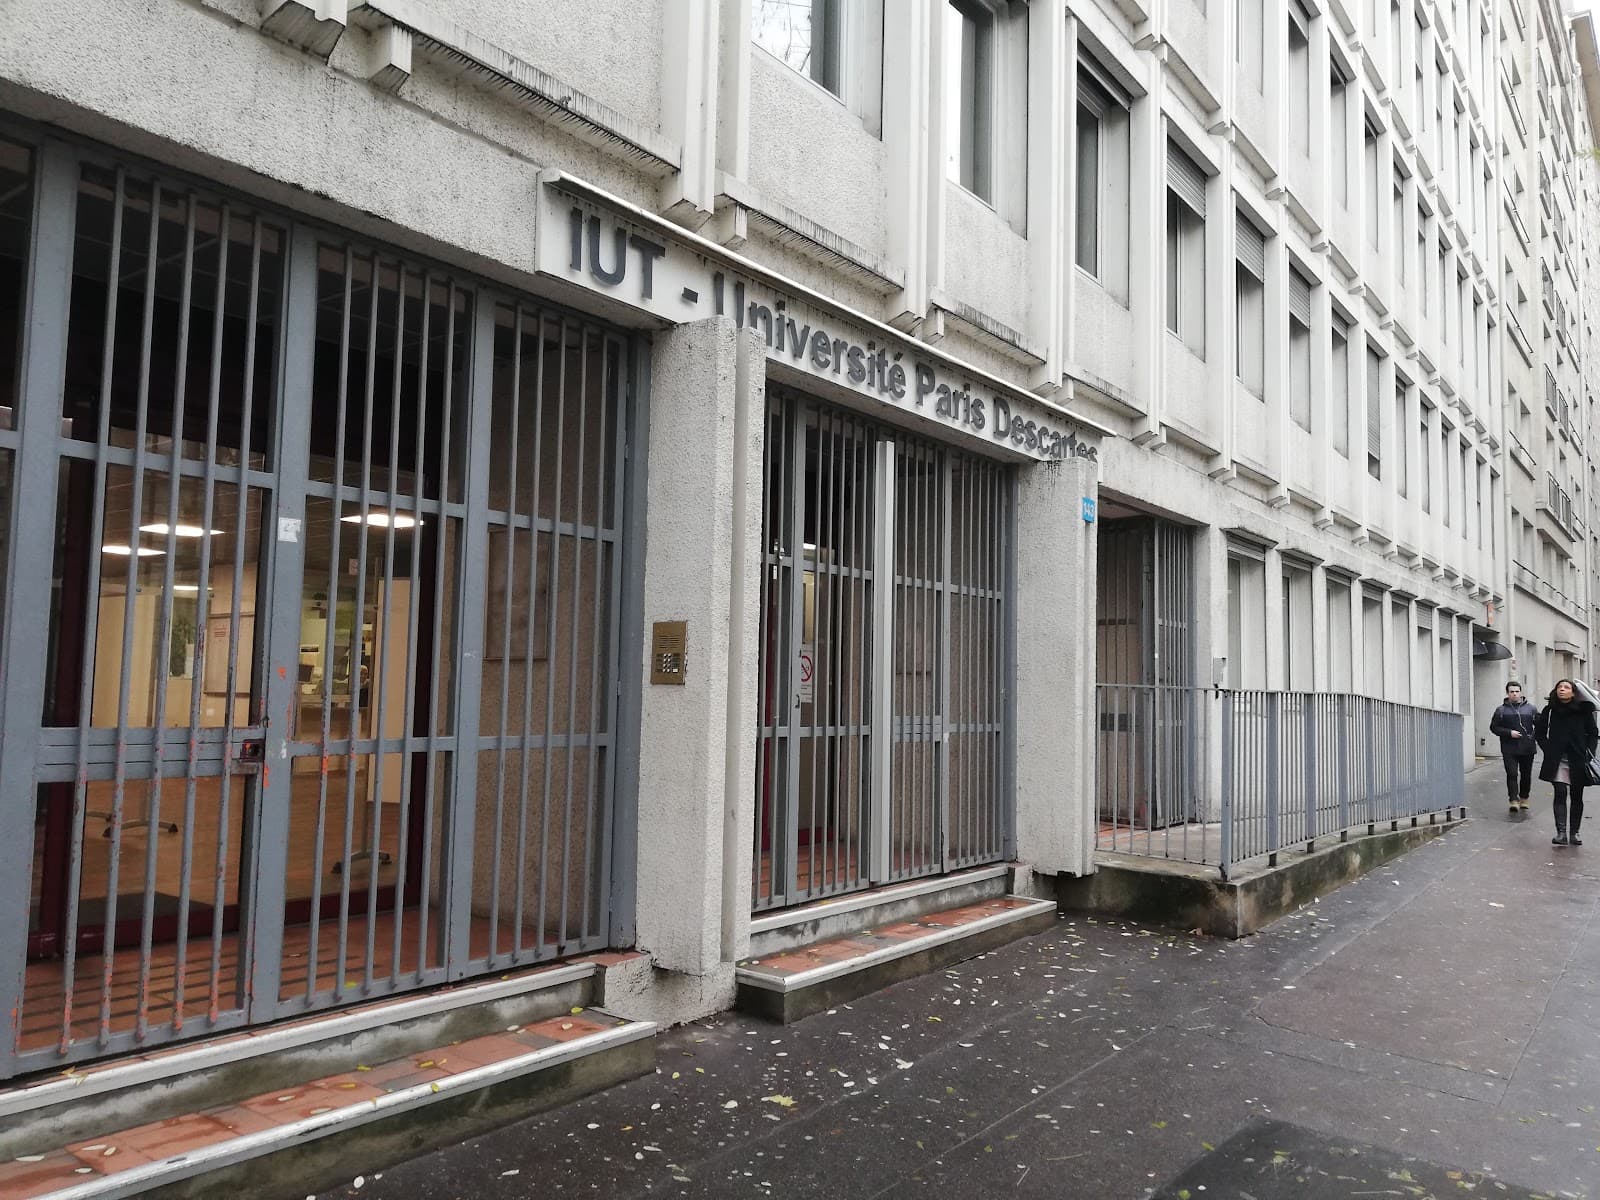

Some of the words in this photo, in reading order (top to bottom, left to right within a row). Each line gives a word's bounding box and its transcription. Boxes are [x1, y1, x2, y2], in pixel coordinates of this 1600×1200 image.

[570, 206, 665, 300] IUT
[713, 271, 906, 399] Université
[915, 362, 986, 430] Paris
[993, 397, 1098, 464] Descartes
